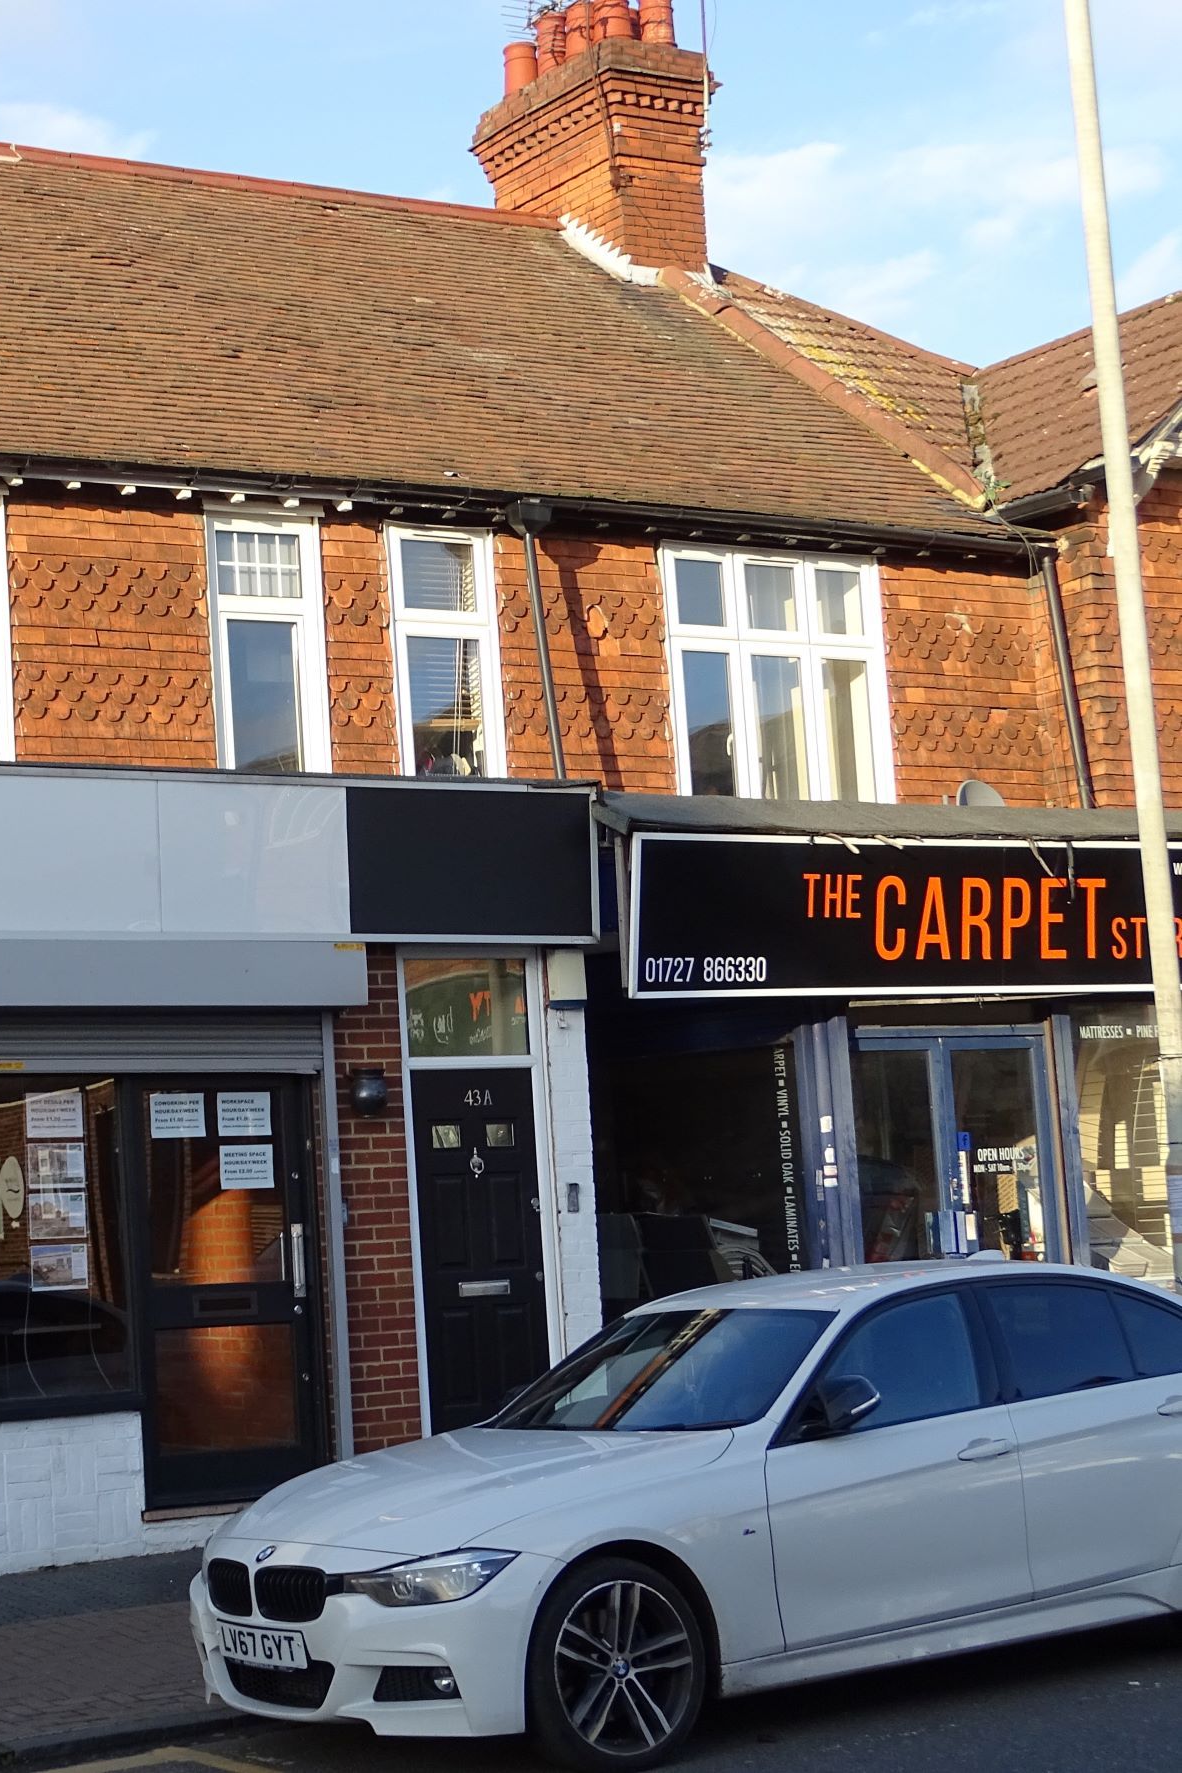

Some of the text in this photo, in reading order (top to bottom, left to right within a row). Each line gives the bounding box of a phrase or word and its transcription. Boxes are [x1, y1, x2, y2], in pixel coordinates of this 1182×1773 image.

[803, 873, 1182, 961] THE CARPET STR
[644, 956, 768, 984] 01727 866330
[1079, 1025, 1124, 1038] MATTRESSES
[1135, 1025, 1152, 1038] PINE
[463, 1089, 493, 1106] 43A
[775, 1089, 790, 1118] VINYL
[779, 1130, 794, 1184] SOLID OAK
[977, 1147, 1025, 1162] OPEN HOURS
[783, 1195, 800, 1251] LAMINATES
[220, 1625, 296, 1663] LV67 GYT
